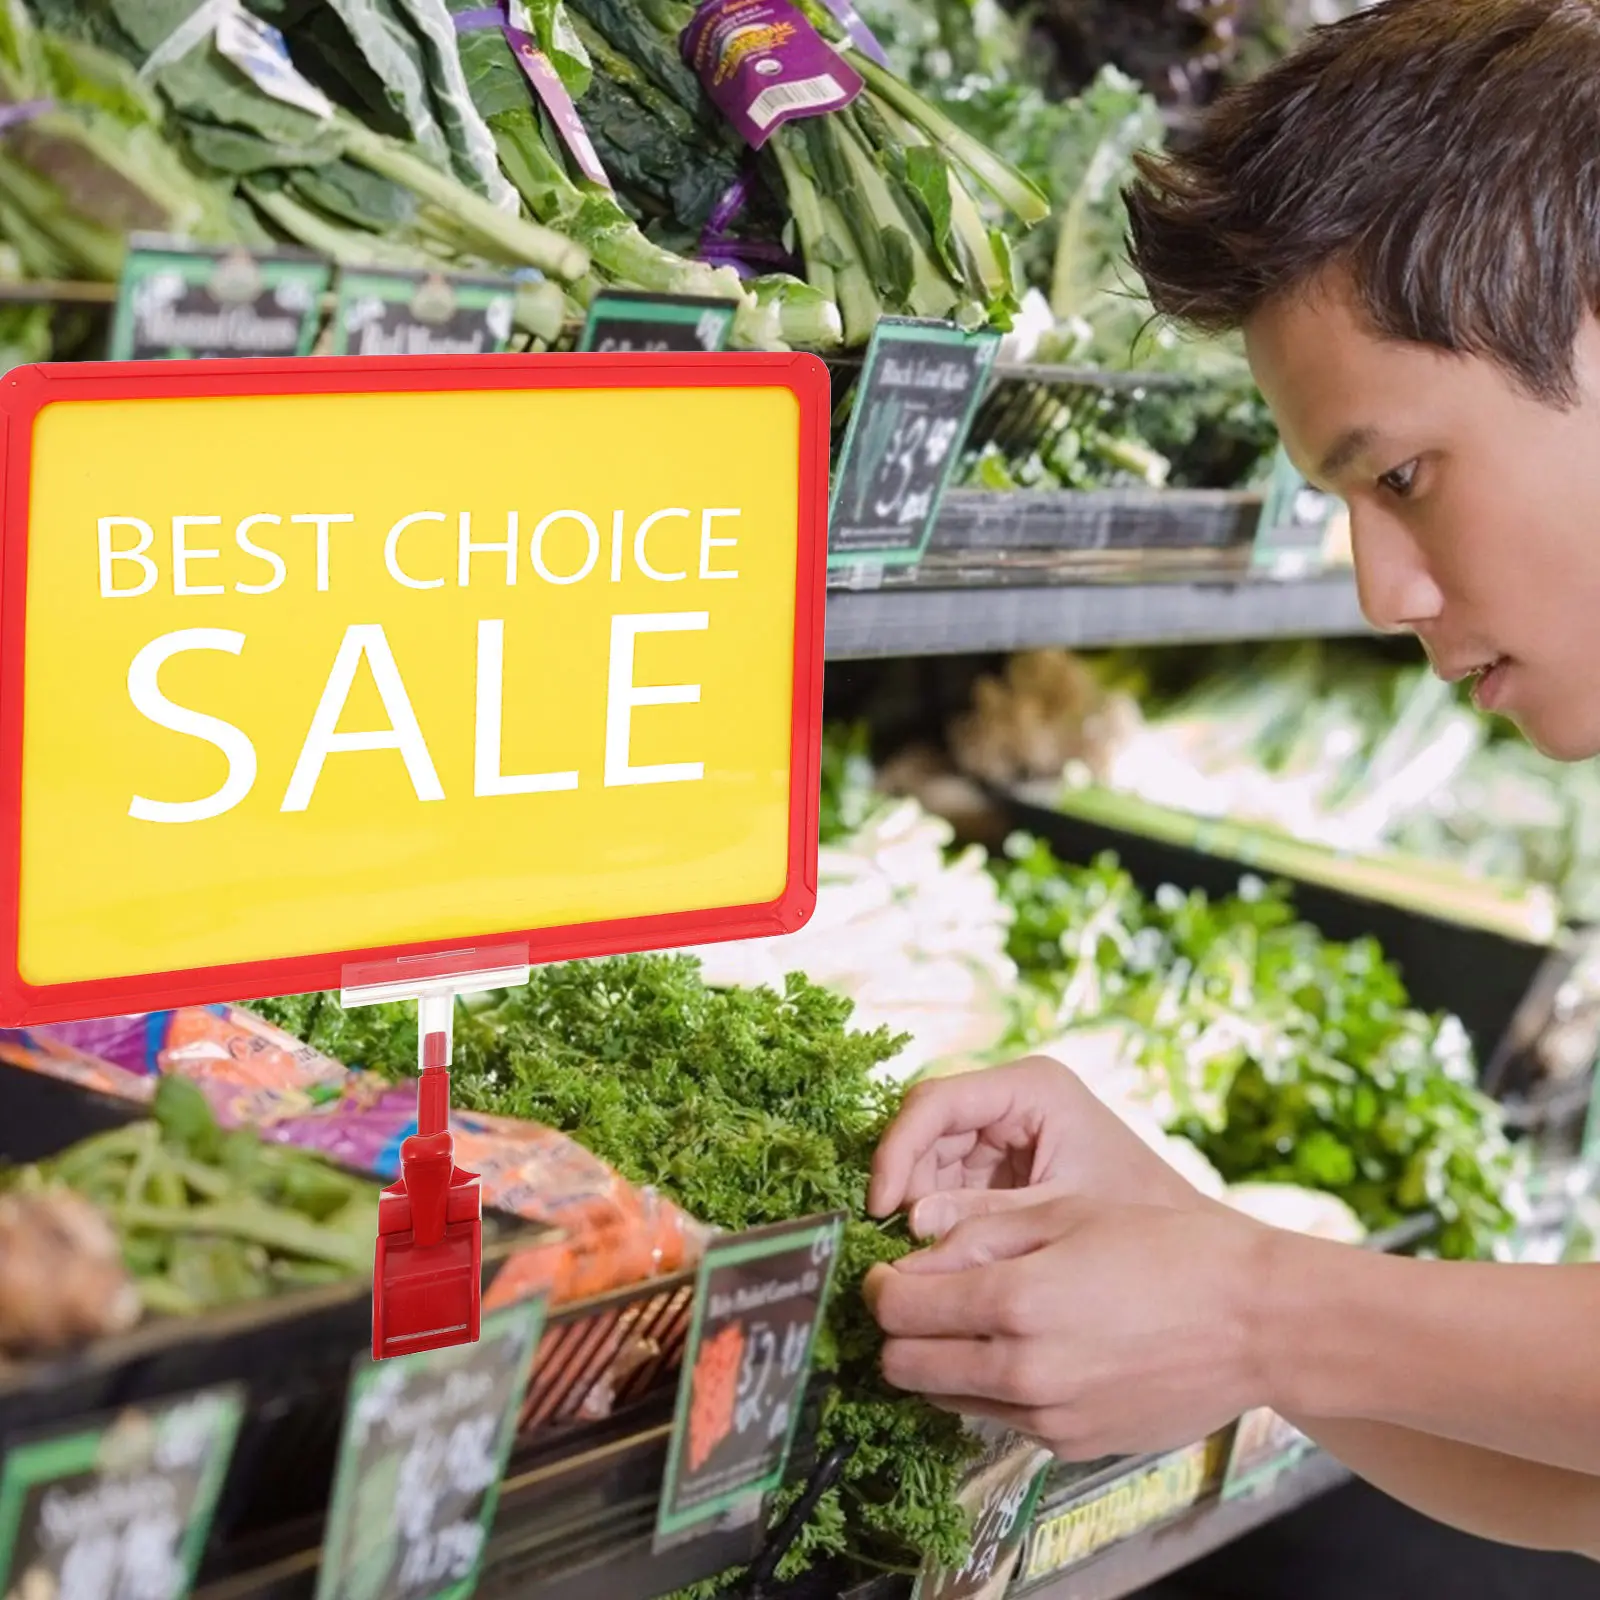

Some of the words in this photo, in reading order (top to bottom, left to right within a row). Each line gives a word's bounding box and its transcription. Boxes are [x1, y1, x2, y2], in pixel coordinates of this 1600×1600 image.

[97, 513, 355, 598] BEST
[383, 507, 741, 590] CHOICE
[127, 610, 710, 823] SALE
